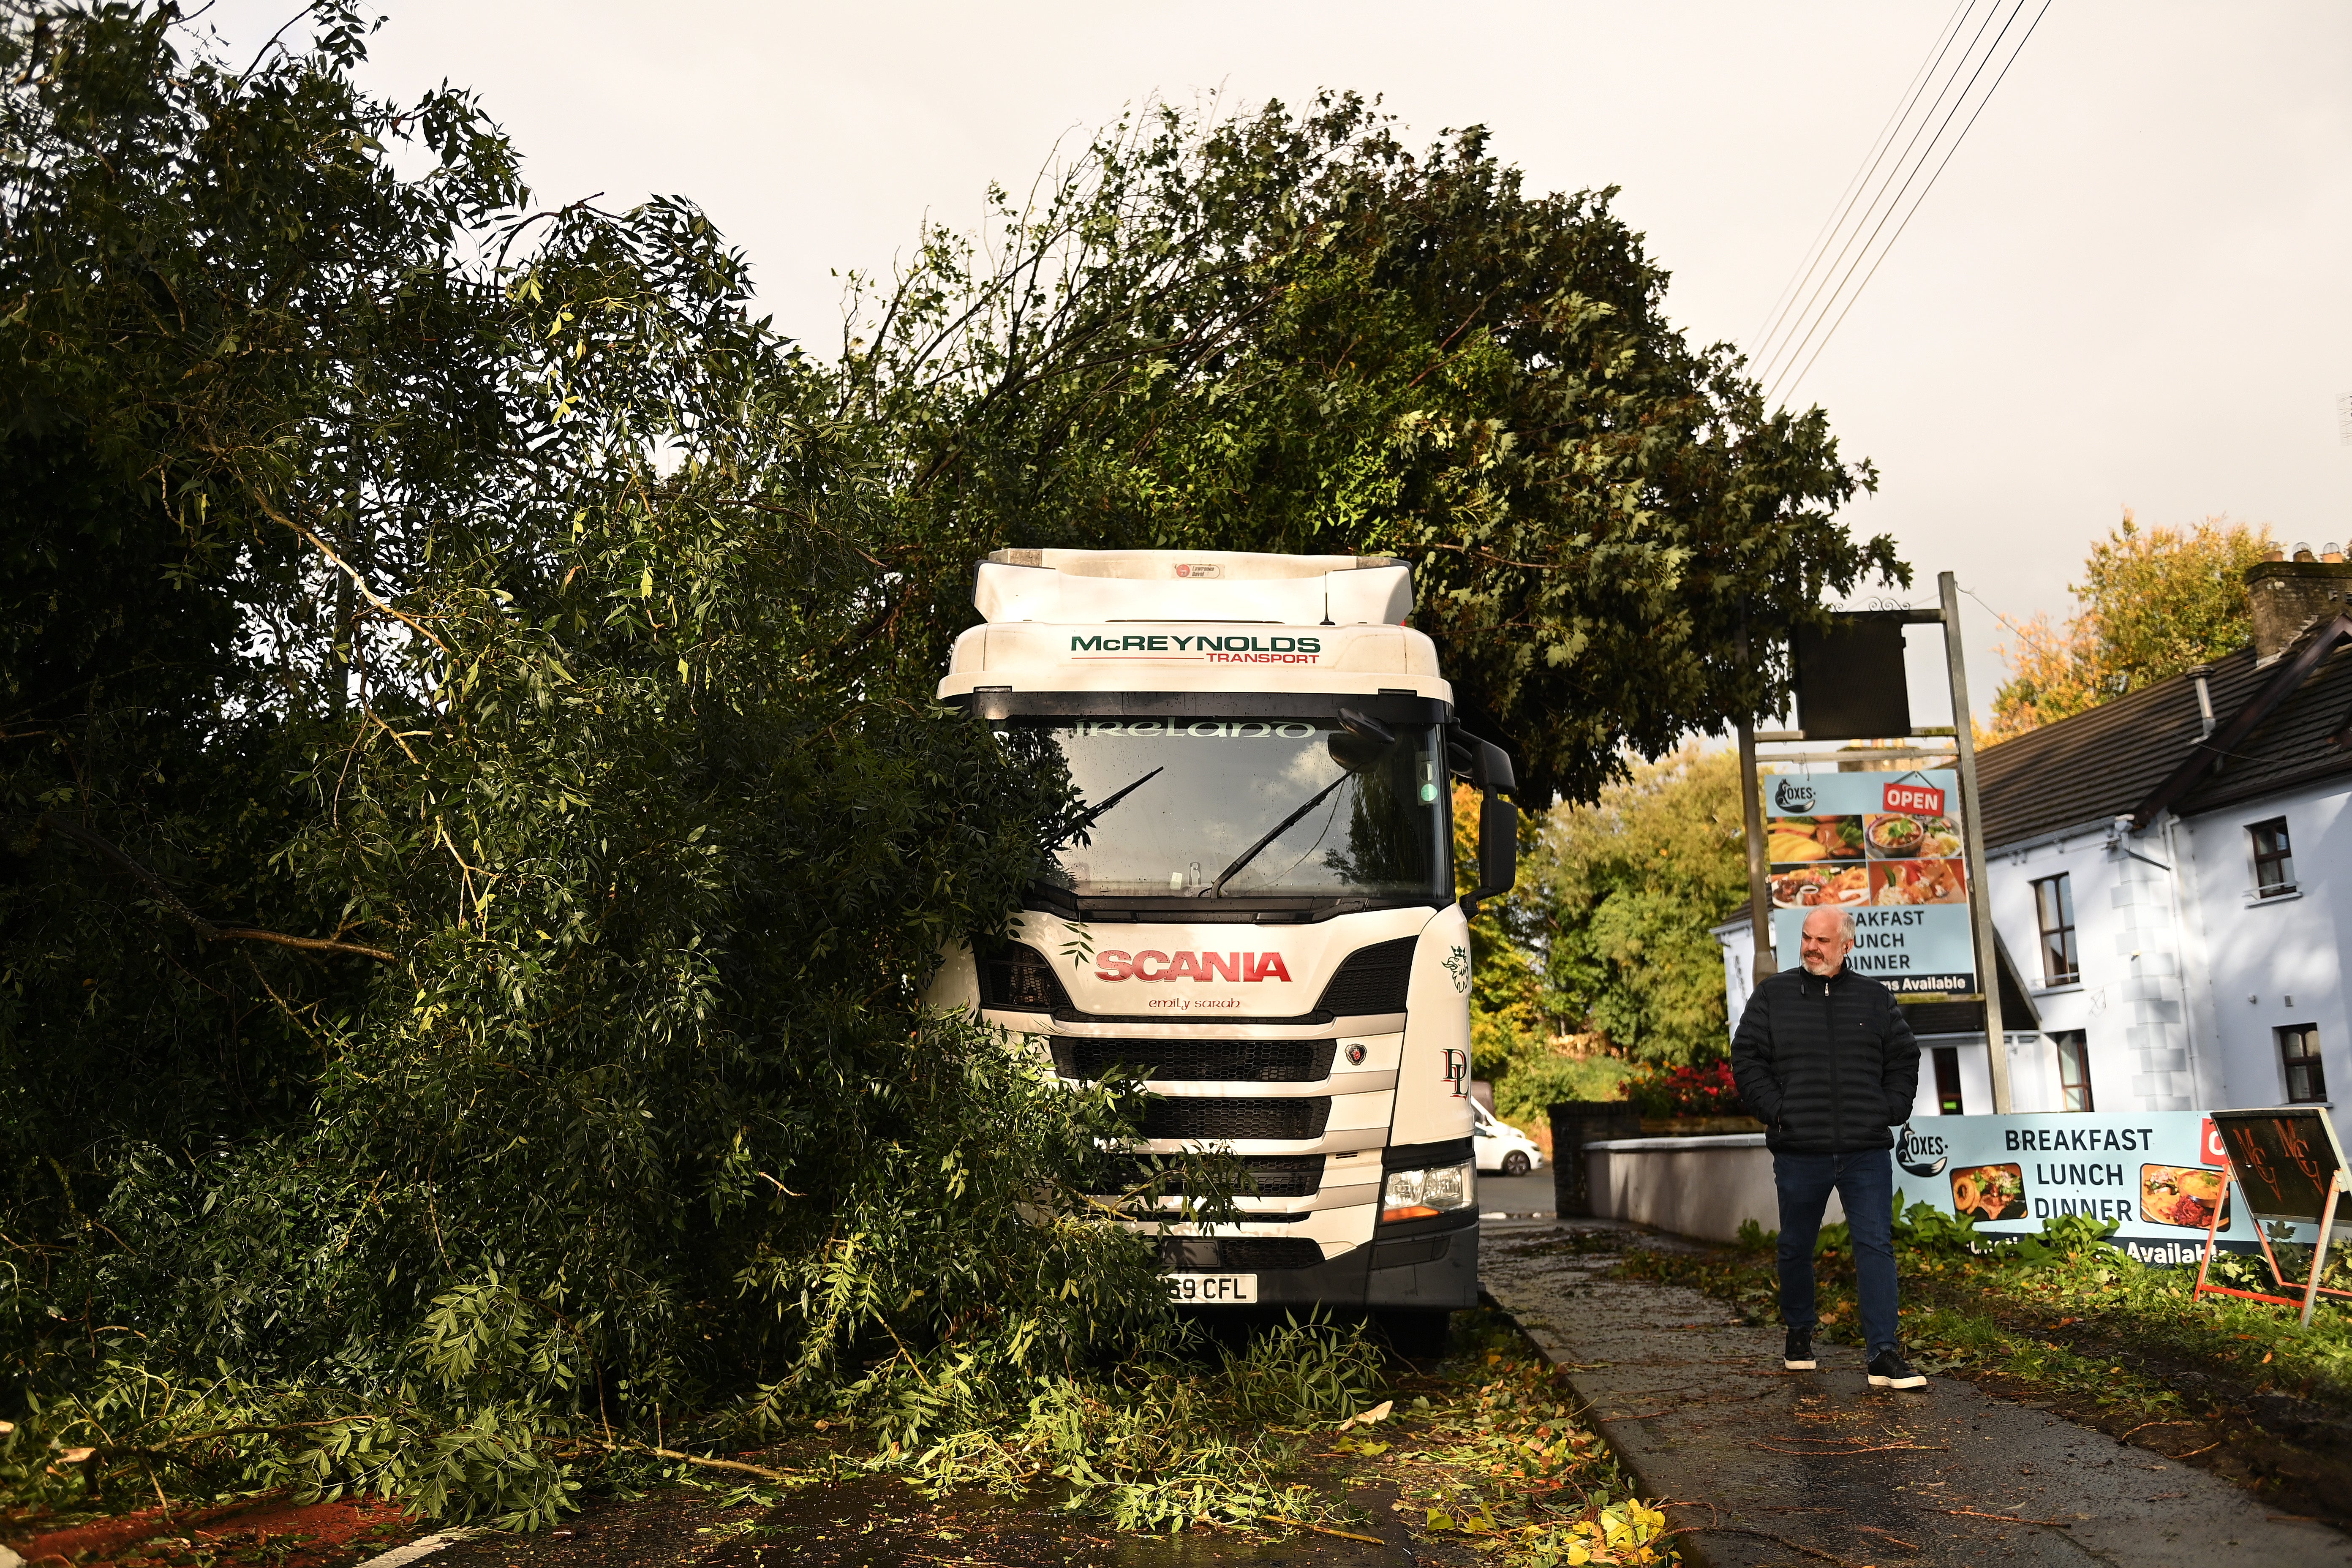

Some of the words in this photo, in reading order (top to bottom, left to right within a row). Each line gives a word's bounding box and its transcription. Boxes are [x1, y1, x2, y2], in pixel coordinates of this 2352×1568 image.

[1071, 636, 1321, 653] McREYNOLDS
[1206, 653, 1320, 664] TRANSPORT
[1886, 789, 1939, 811] OPEN
[1848, 911, 1925, 926] AKFAST
[1854, 932, 1905, 948] UNCH
[1094, 950, 1293, 983] SCANIA
[1902, 976, 1966, 991] Available
[2005, 1128, 2153, 1151] BREAKFAST
[2036, 1163, 2123, 1186] LUNCH
[2034, 1198, 2133, 1221] DINNER
[1203, 1278, 1247, 1299] CFL
